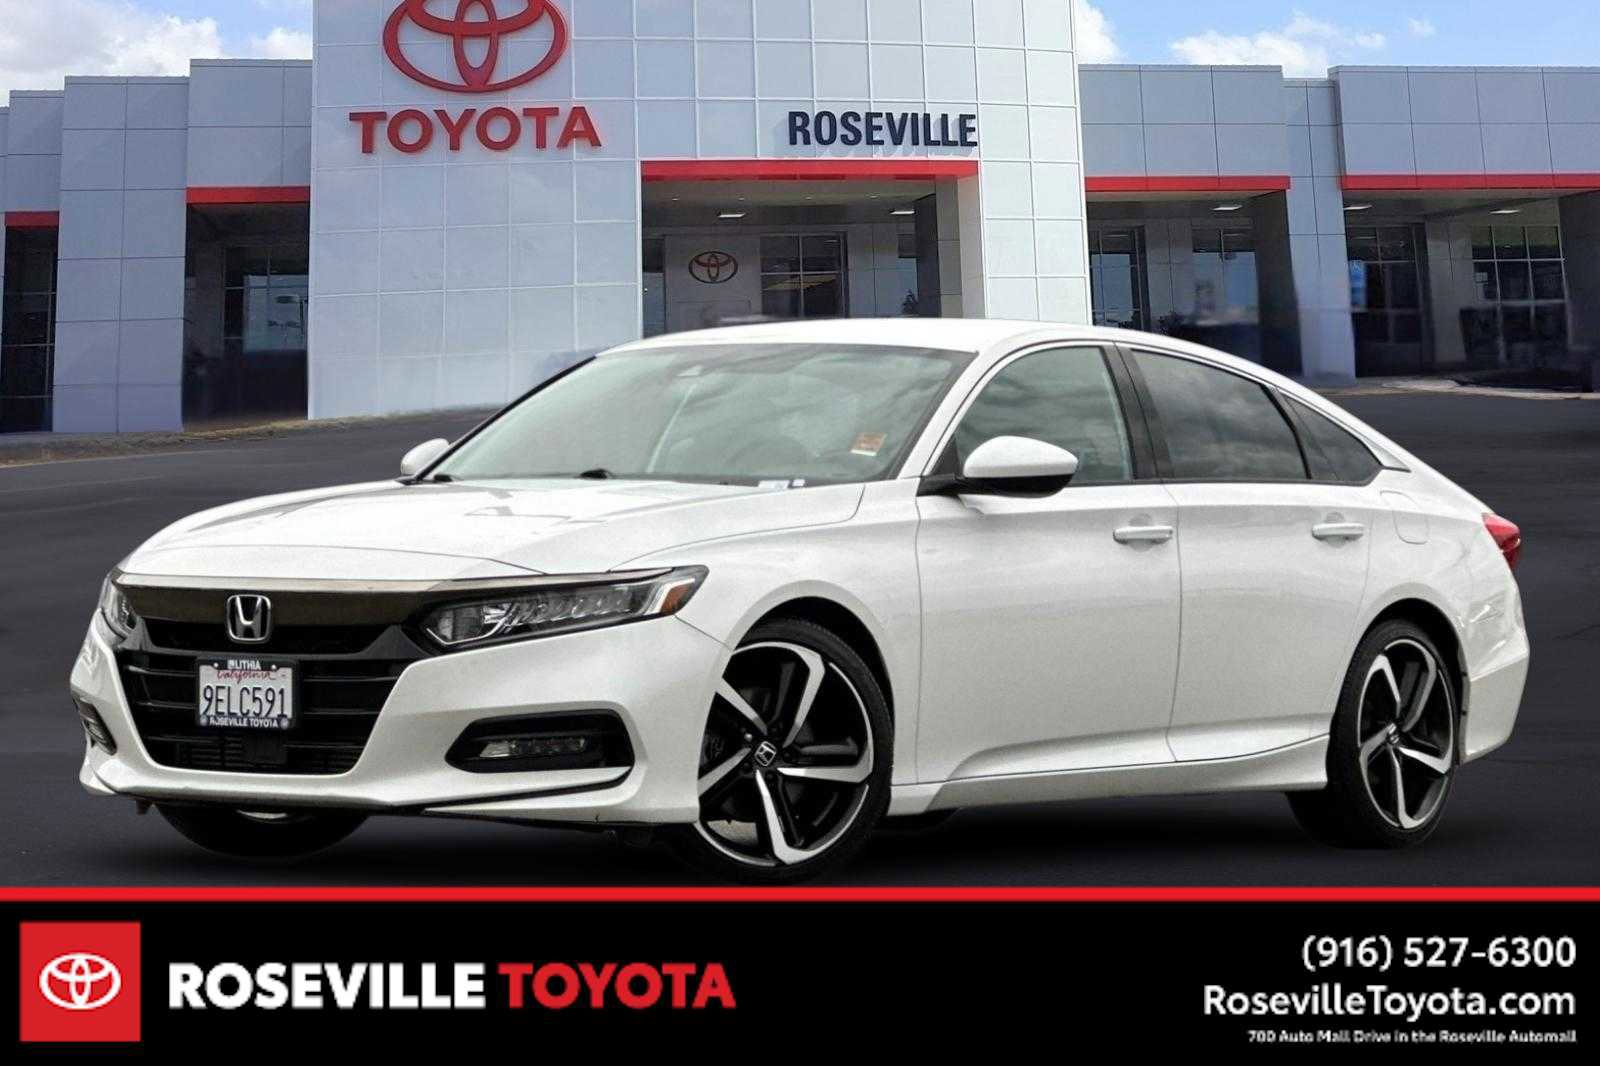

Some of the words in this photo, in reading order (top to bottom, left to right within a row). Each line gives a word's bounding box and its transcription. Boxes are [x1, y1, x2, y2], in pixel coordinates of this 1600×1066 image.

[349, 106, 602, 154] TOYOTA
[788, 110, 978, 147] ROSEVILLE
[217, 669, 276, 684] California
[203, 685, 287, 718] 9ELC591
[209, 716, 248, 727] ROSEVILLE
[249, 718, 279, 729] TOYOTA
